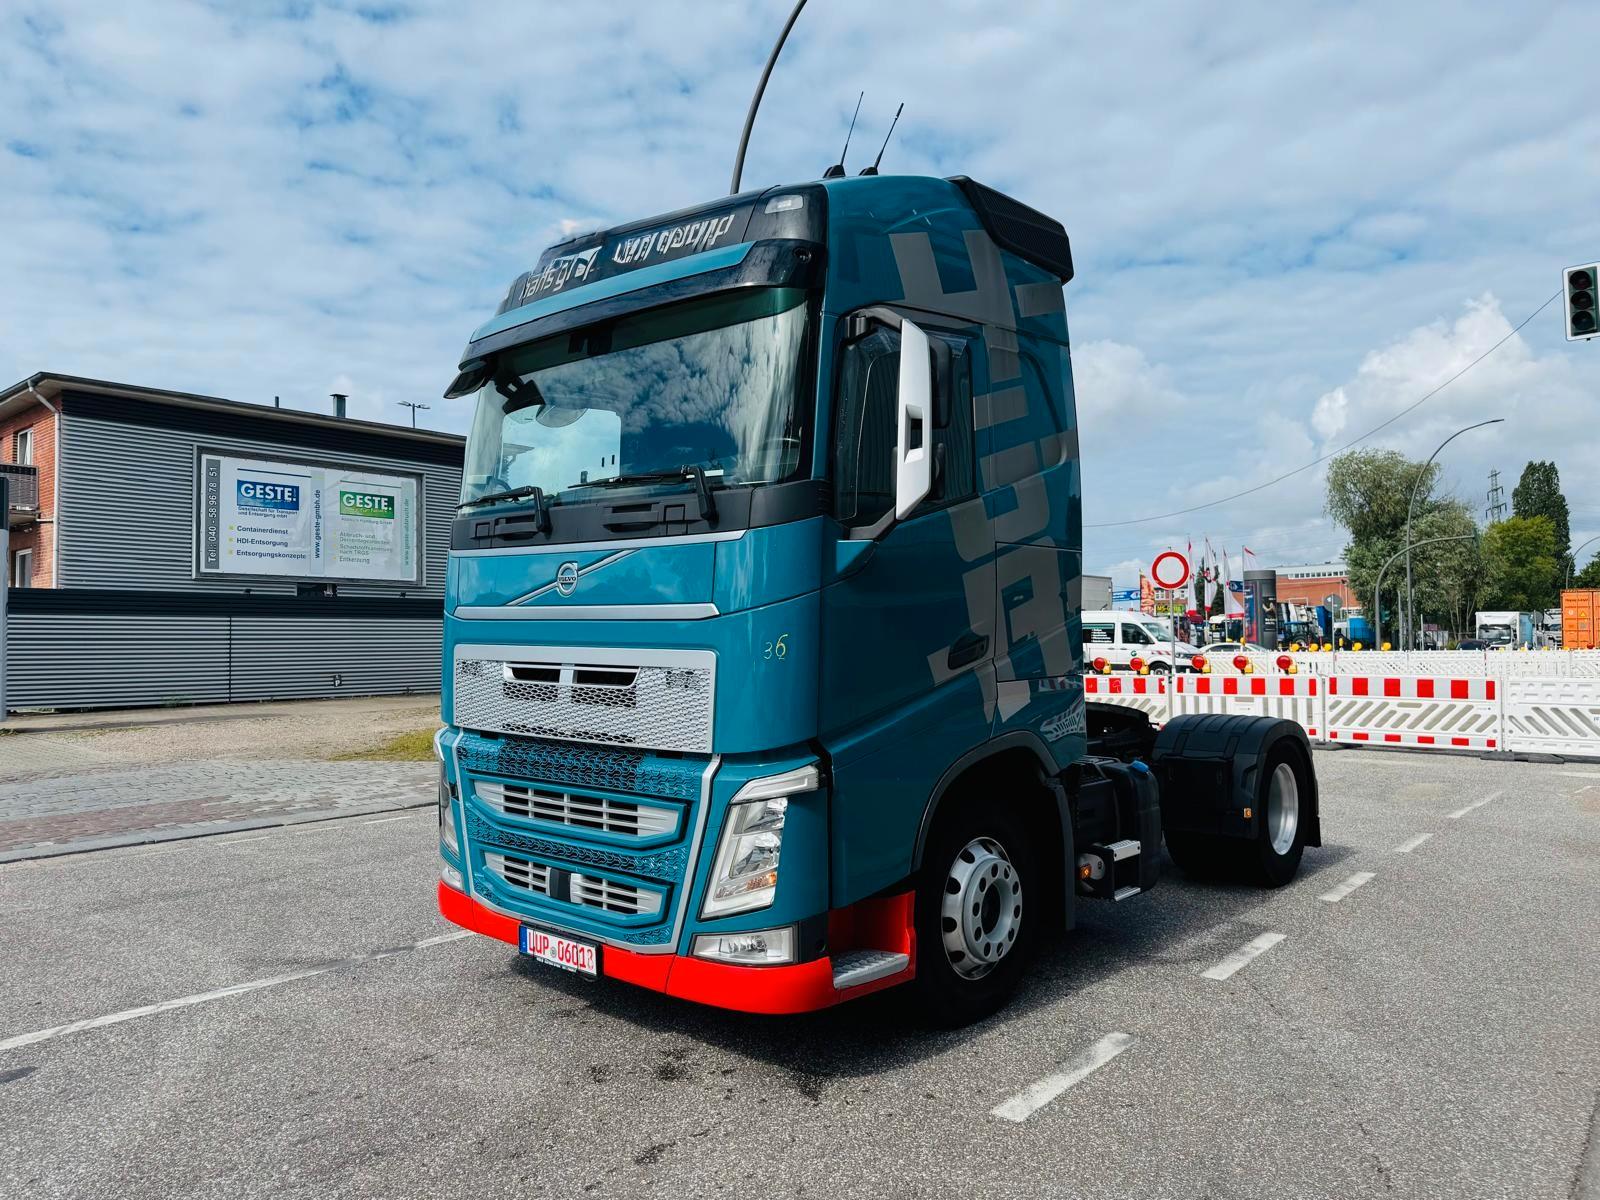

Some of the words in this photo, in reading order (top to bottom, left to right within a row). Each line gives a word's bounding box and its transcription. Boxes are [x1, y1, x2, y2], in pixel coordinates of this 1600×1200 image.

[209, 467, 217, 477] 51
[209, 482, 217, 493] 78
[208, 495, 217, 506] 96
[208, 508, 217, 518] 58
[314, 489, 322, 559] www.geste-gmbh.de
[208, 526, 217, 542] 040
[236, 525, 289, 535] Containerdienst
[236, 537, 288, 547] HDI-Entsorgung
[208, 544, 217, 563] Tel.:
[236, 549, 306, 559] Entsorgungskonzepte
[763, 634, 788, 660] 36
[528, 931, 549, 955] LUP
